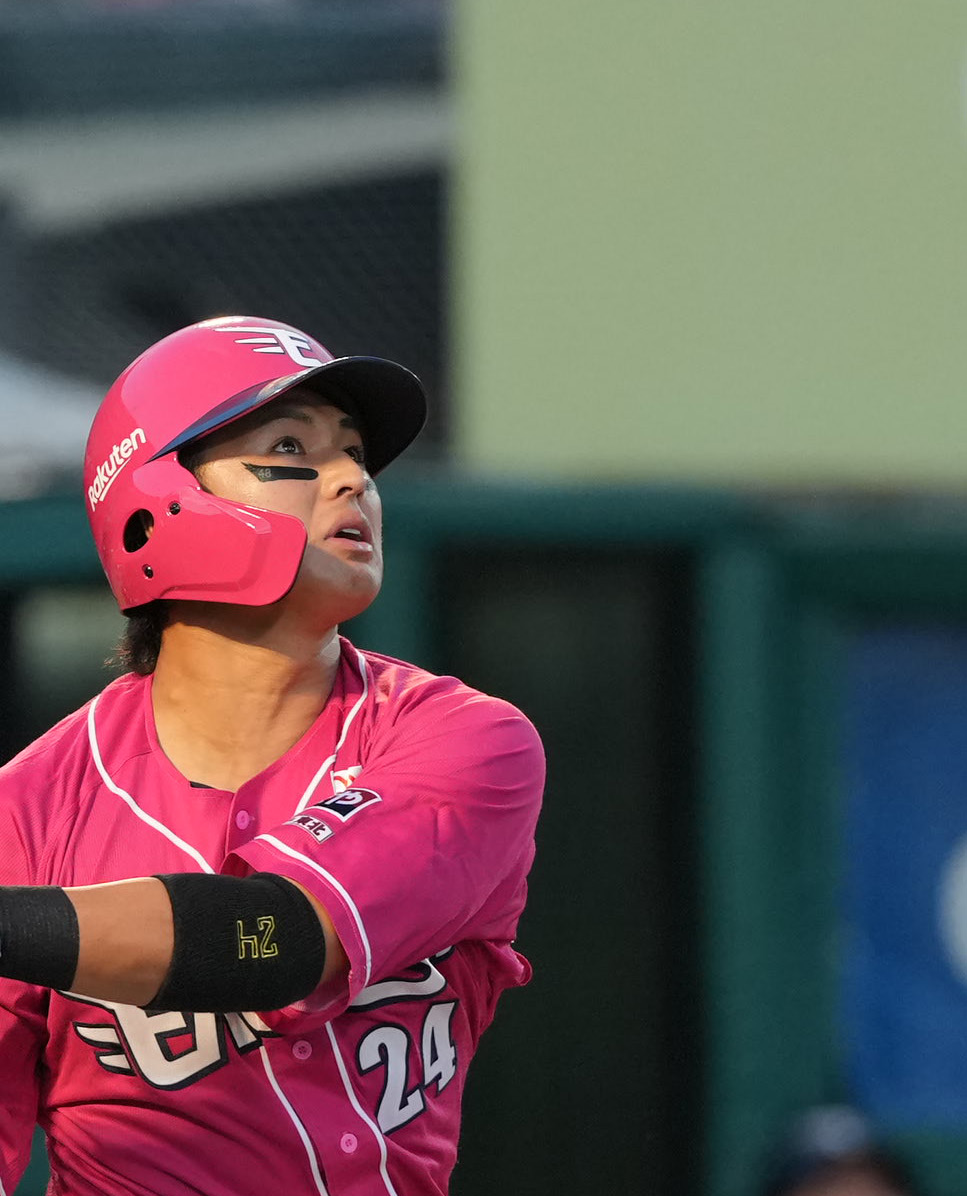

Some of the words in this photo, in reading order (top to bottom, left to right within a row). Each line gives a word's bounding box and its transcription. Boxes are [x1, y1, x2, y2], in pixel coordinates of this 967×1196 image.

[88, 427, 147, 512] Rakuten
[236, 915, 279, 960] 24
[357, 1000, 459, 1136] 24
